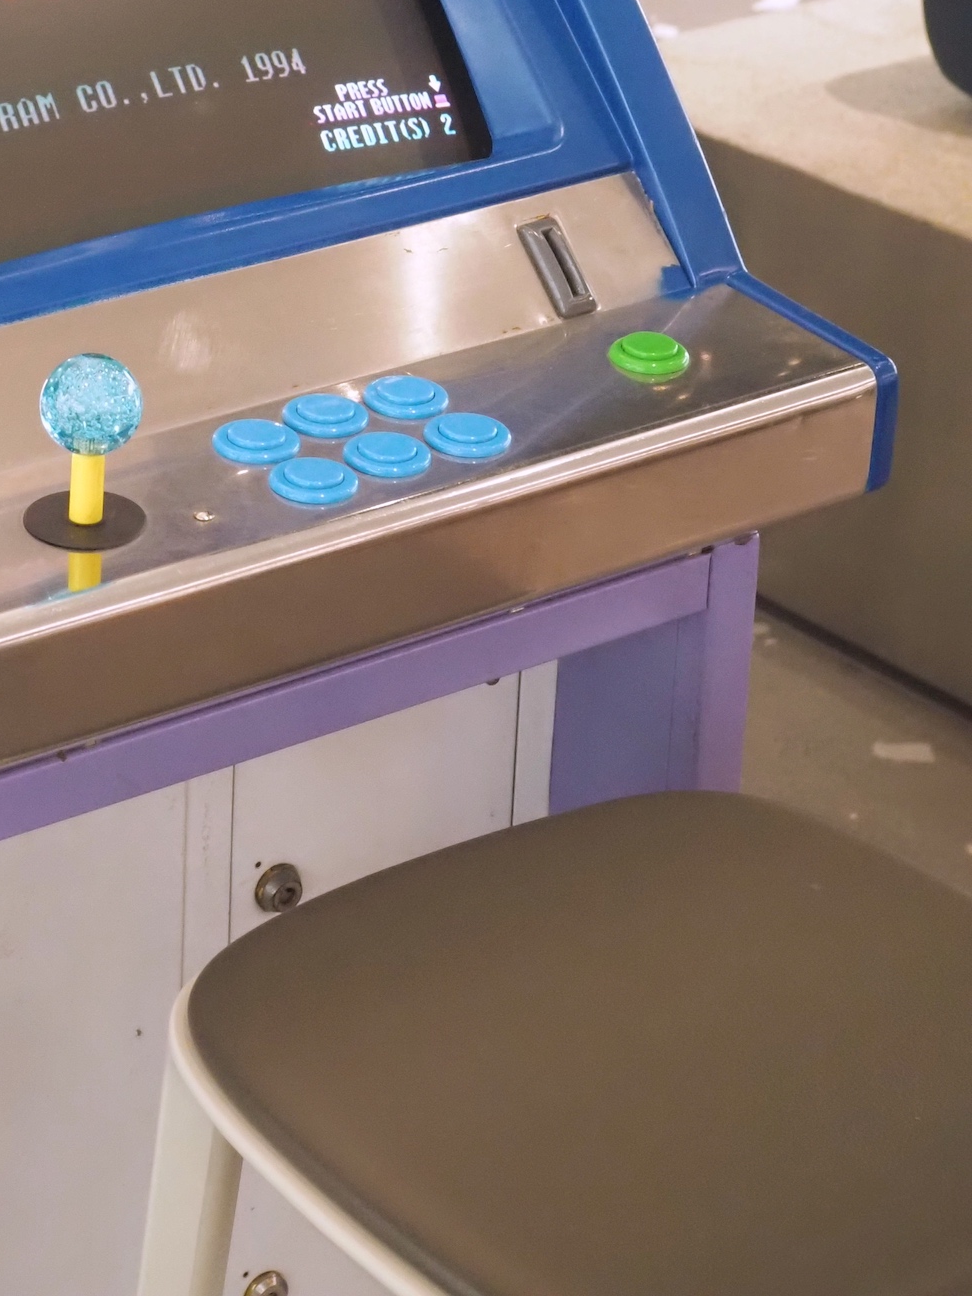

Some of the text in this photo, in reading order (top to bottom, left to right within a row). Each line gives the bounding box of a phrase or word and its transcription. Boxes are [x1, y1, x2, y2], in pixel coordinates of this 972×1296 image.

[240, 47, 307, 84] 1994
[312, 91, 434, 124] START BUTTON
[334, 78, 389, 102] PRESS
[319, 113, 457, 153] CREDIT(S) 2
